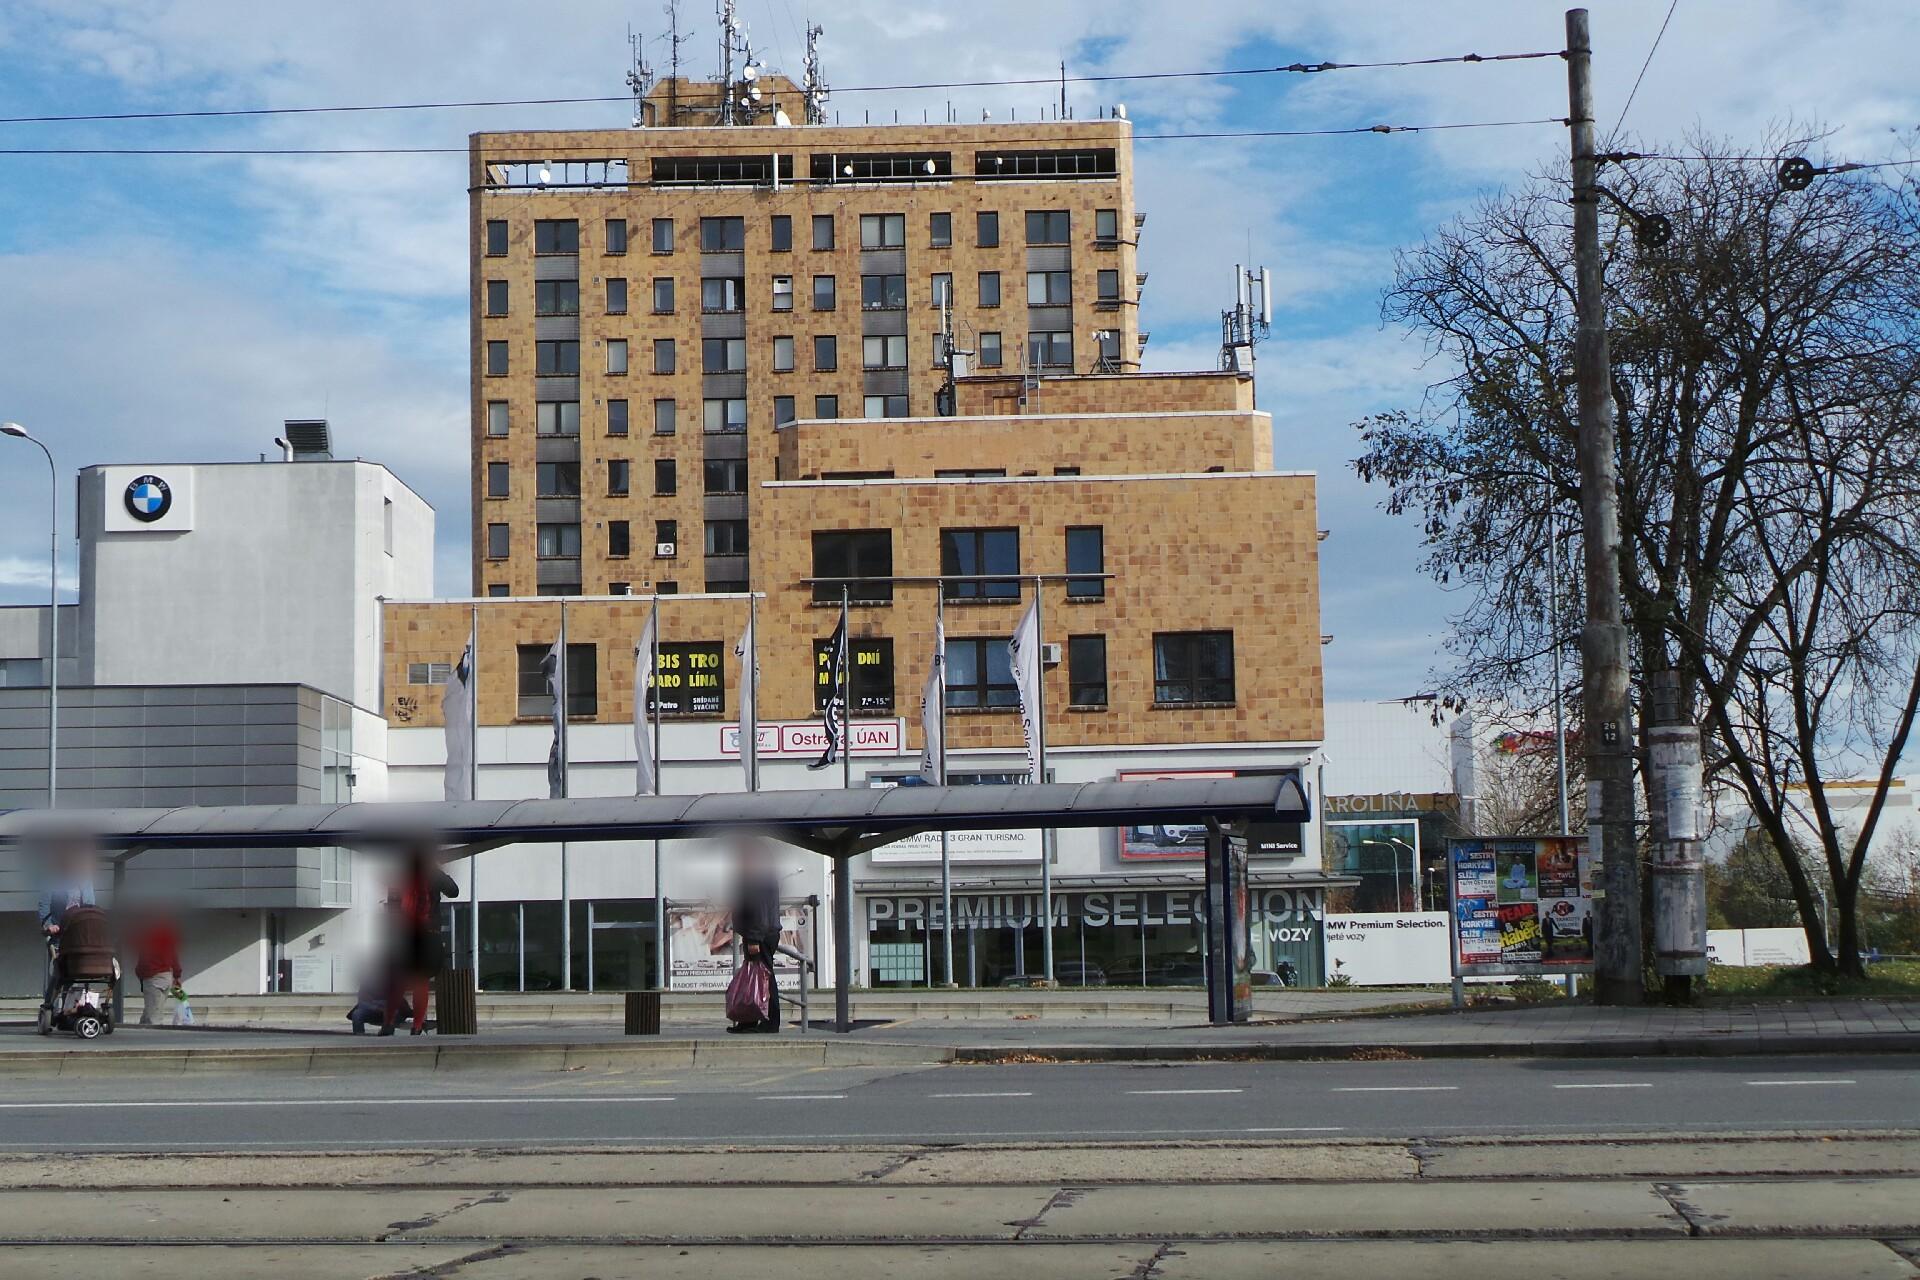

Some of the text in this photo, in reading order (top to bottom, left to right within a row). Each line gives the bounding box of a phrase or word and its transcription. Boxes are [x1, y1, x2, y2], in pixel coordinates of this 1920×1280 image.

[128, 476, 169, 492] BMW
[688, 653, 719, 668] TRO
[857, 648, 881, 665] DNÍ
[688, 671, 718, 688] LÍNA
[1603, 721, 1616, 731] 26
[856, 727, 890, 744] ÚAN
[1604, 732, 1616, 742] 12
[1323, 795, 1419, 813] AROLINA
[924, 832, 947, 842] ŘAD
[950, 833, 956, 842] 3
[957, 833, 983, 842] GRAN
[984, 833, 1026, 842] TURISMO.
[1276, 842, 1299, 850] Service
[870, 888, 1323, 931] PREMIUM SELECION
[1326, 918, 1446, 930] MW Premium Selection.
[1269, 927, 1313, 942] VOZY
[1326, 932, 1366, 943] jeté vozy
